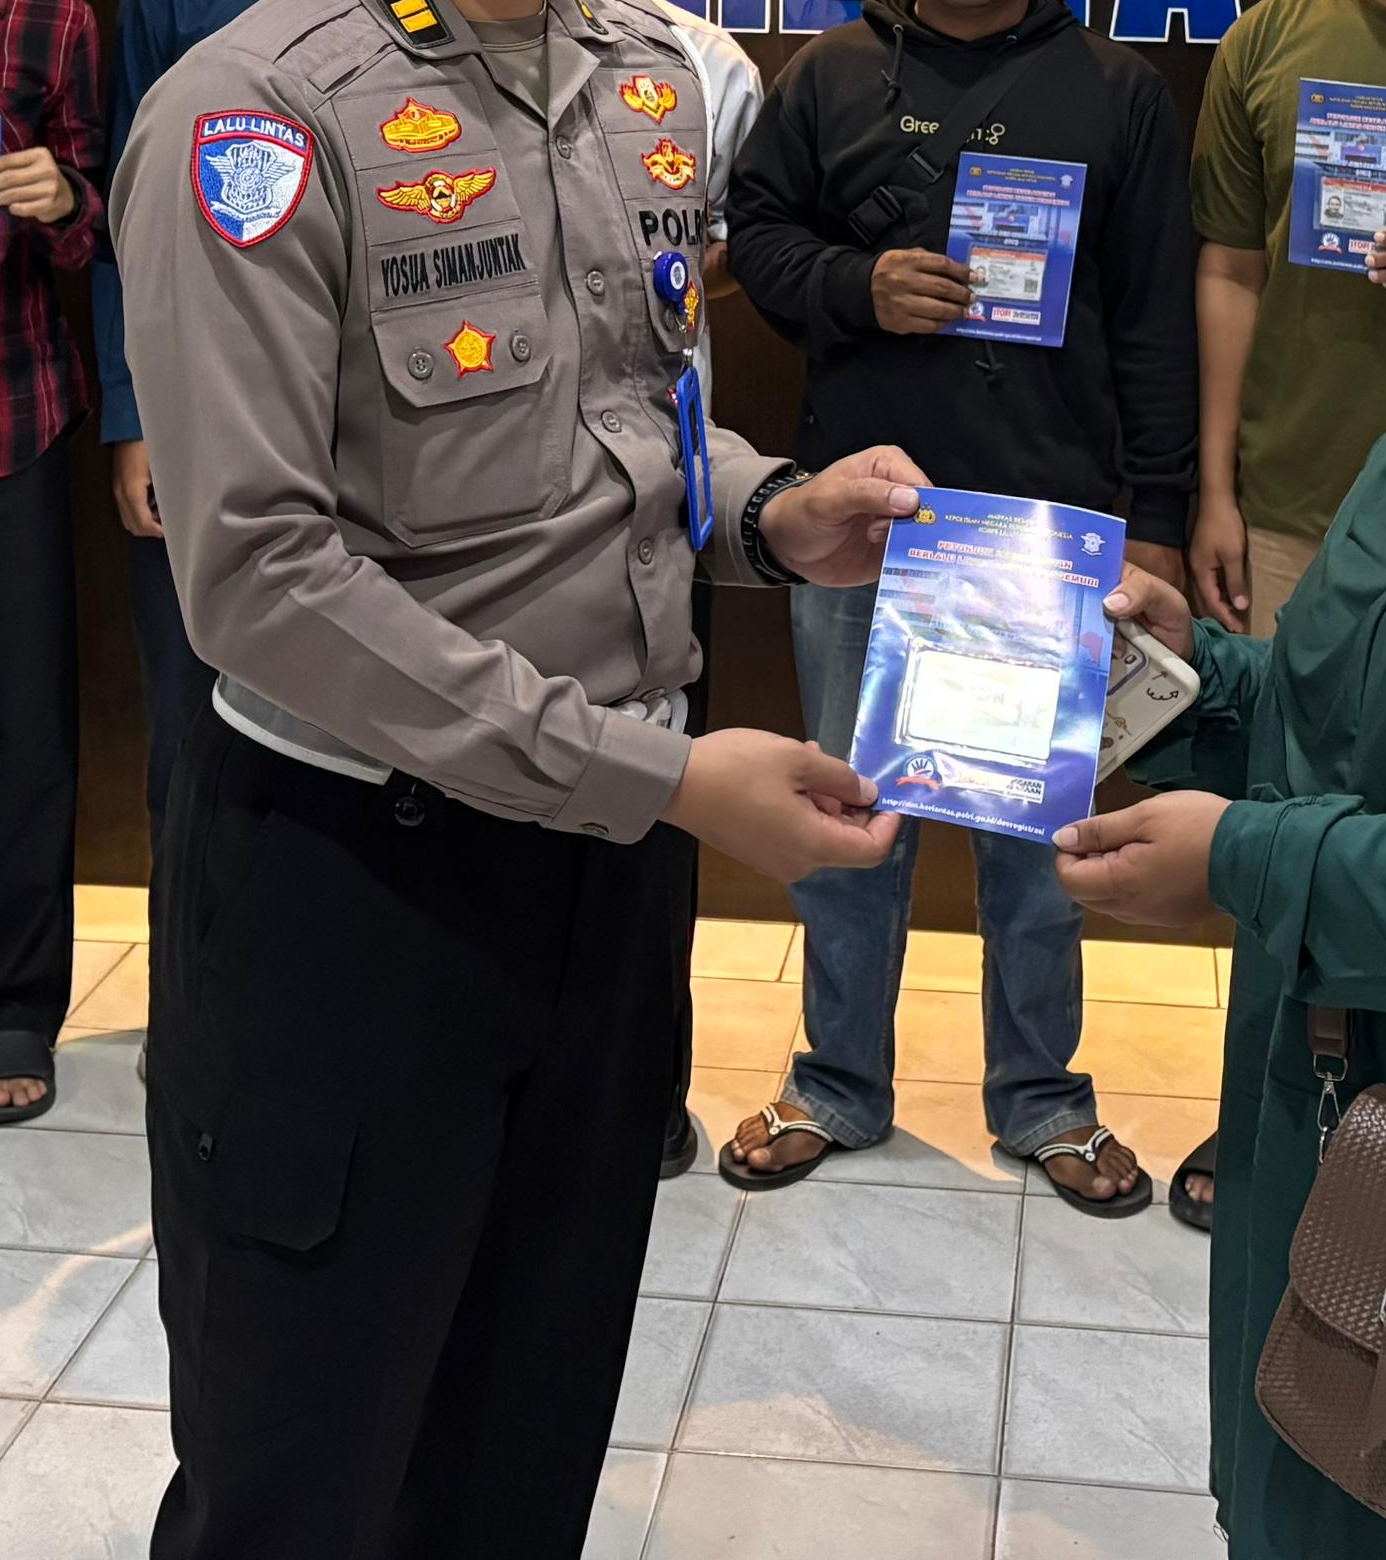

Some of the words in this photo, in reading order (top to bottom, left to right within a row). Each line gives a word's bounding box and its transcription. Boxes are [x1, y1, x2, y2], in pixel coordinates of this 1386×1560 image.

[204, 117, 246, 136] LALU
[251, 119, 305, 147] LINTAS
[381, 252, 430, 297] YOSUA
[433, 233, 527, 289] SIMANJUNTAK
